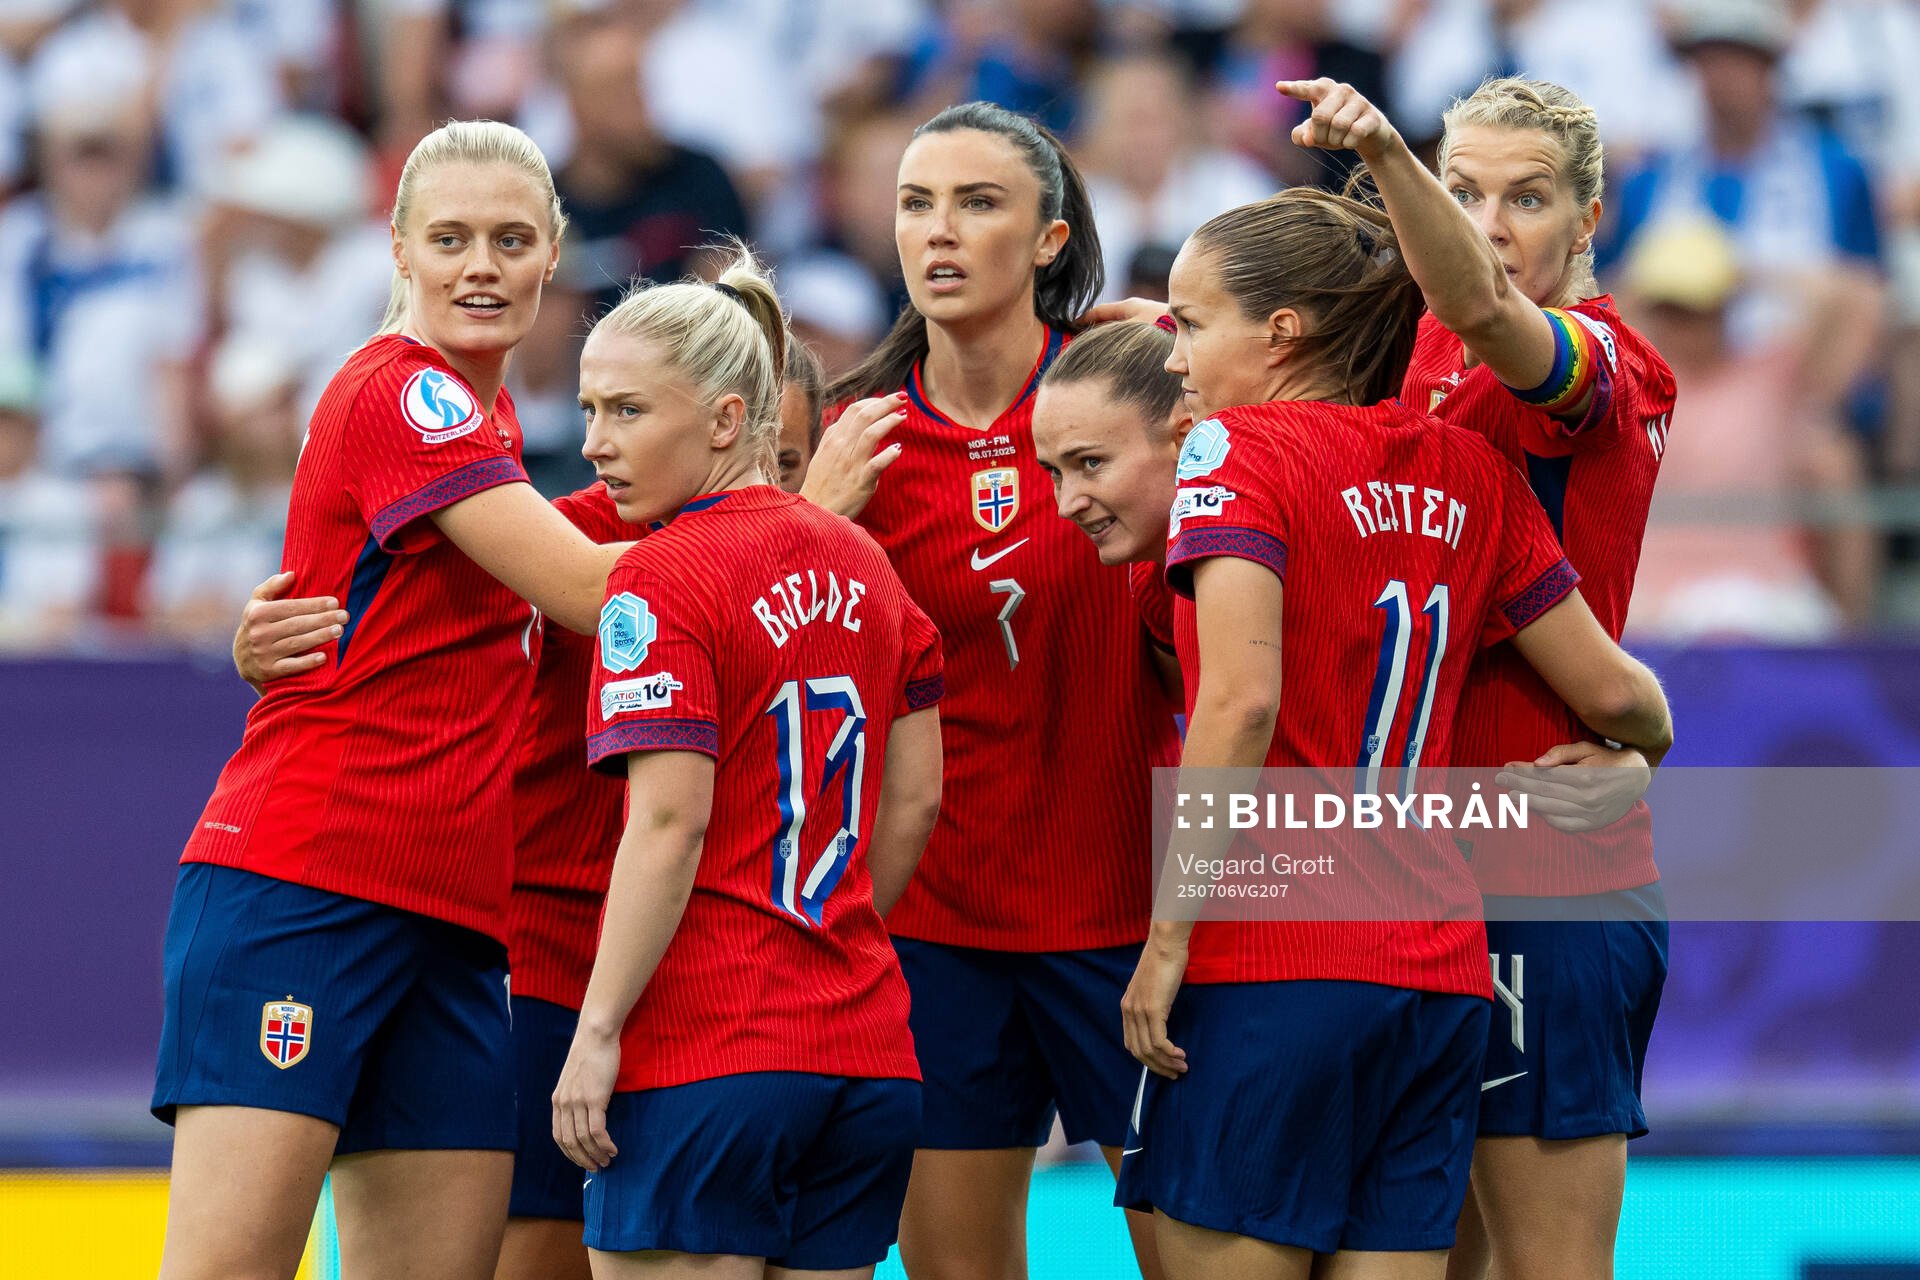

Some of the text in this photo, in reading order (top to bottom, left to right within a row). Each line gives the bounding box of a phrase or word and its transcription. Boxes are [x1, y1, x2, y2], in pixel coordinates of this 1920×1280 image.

[425, 426, 472, 441] SWITZERLAND
[968, 439, 987, 449] NOR
[993, 435, 1010, 446] FIN
[1193, 493, 1219, 507] 10
[1341, 481, 1467, 551] REITEN
[751, 569, 866, 649] BJELDE
[989, 578, 1026, 672] 7
[643, 683, 668, 701] 10
[1353, 579, 1450, 832] 11
